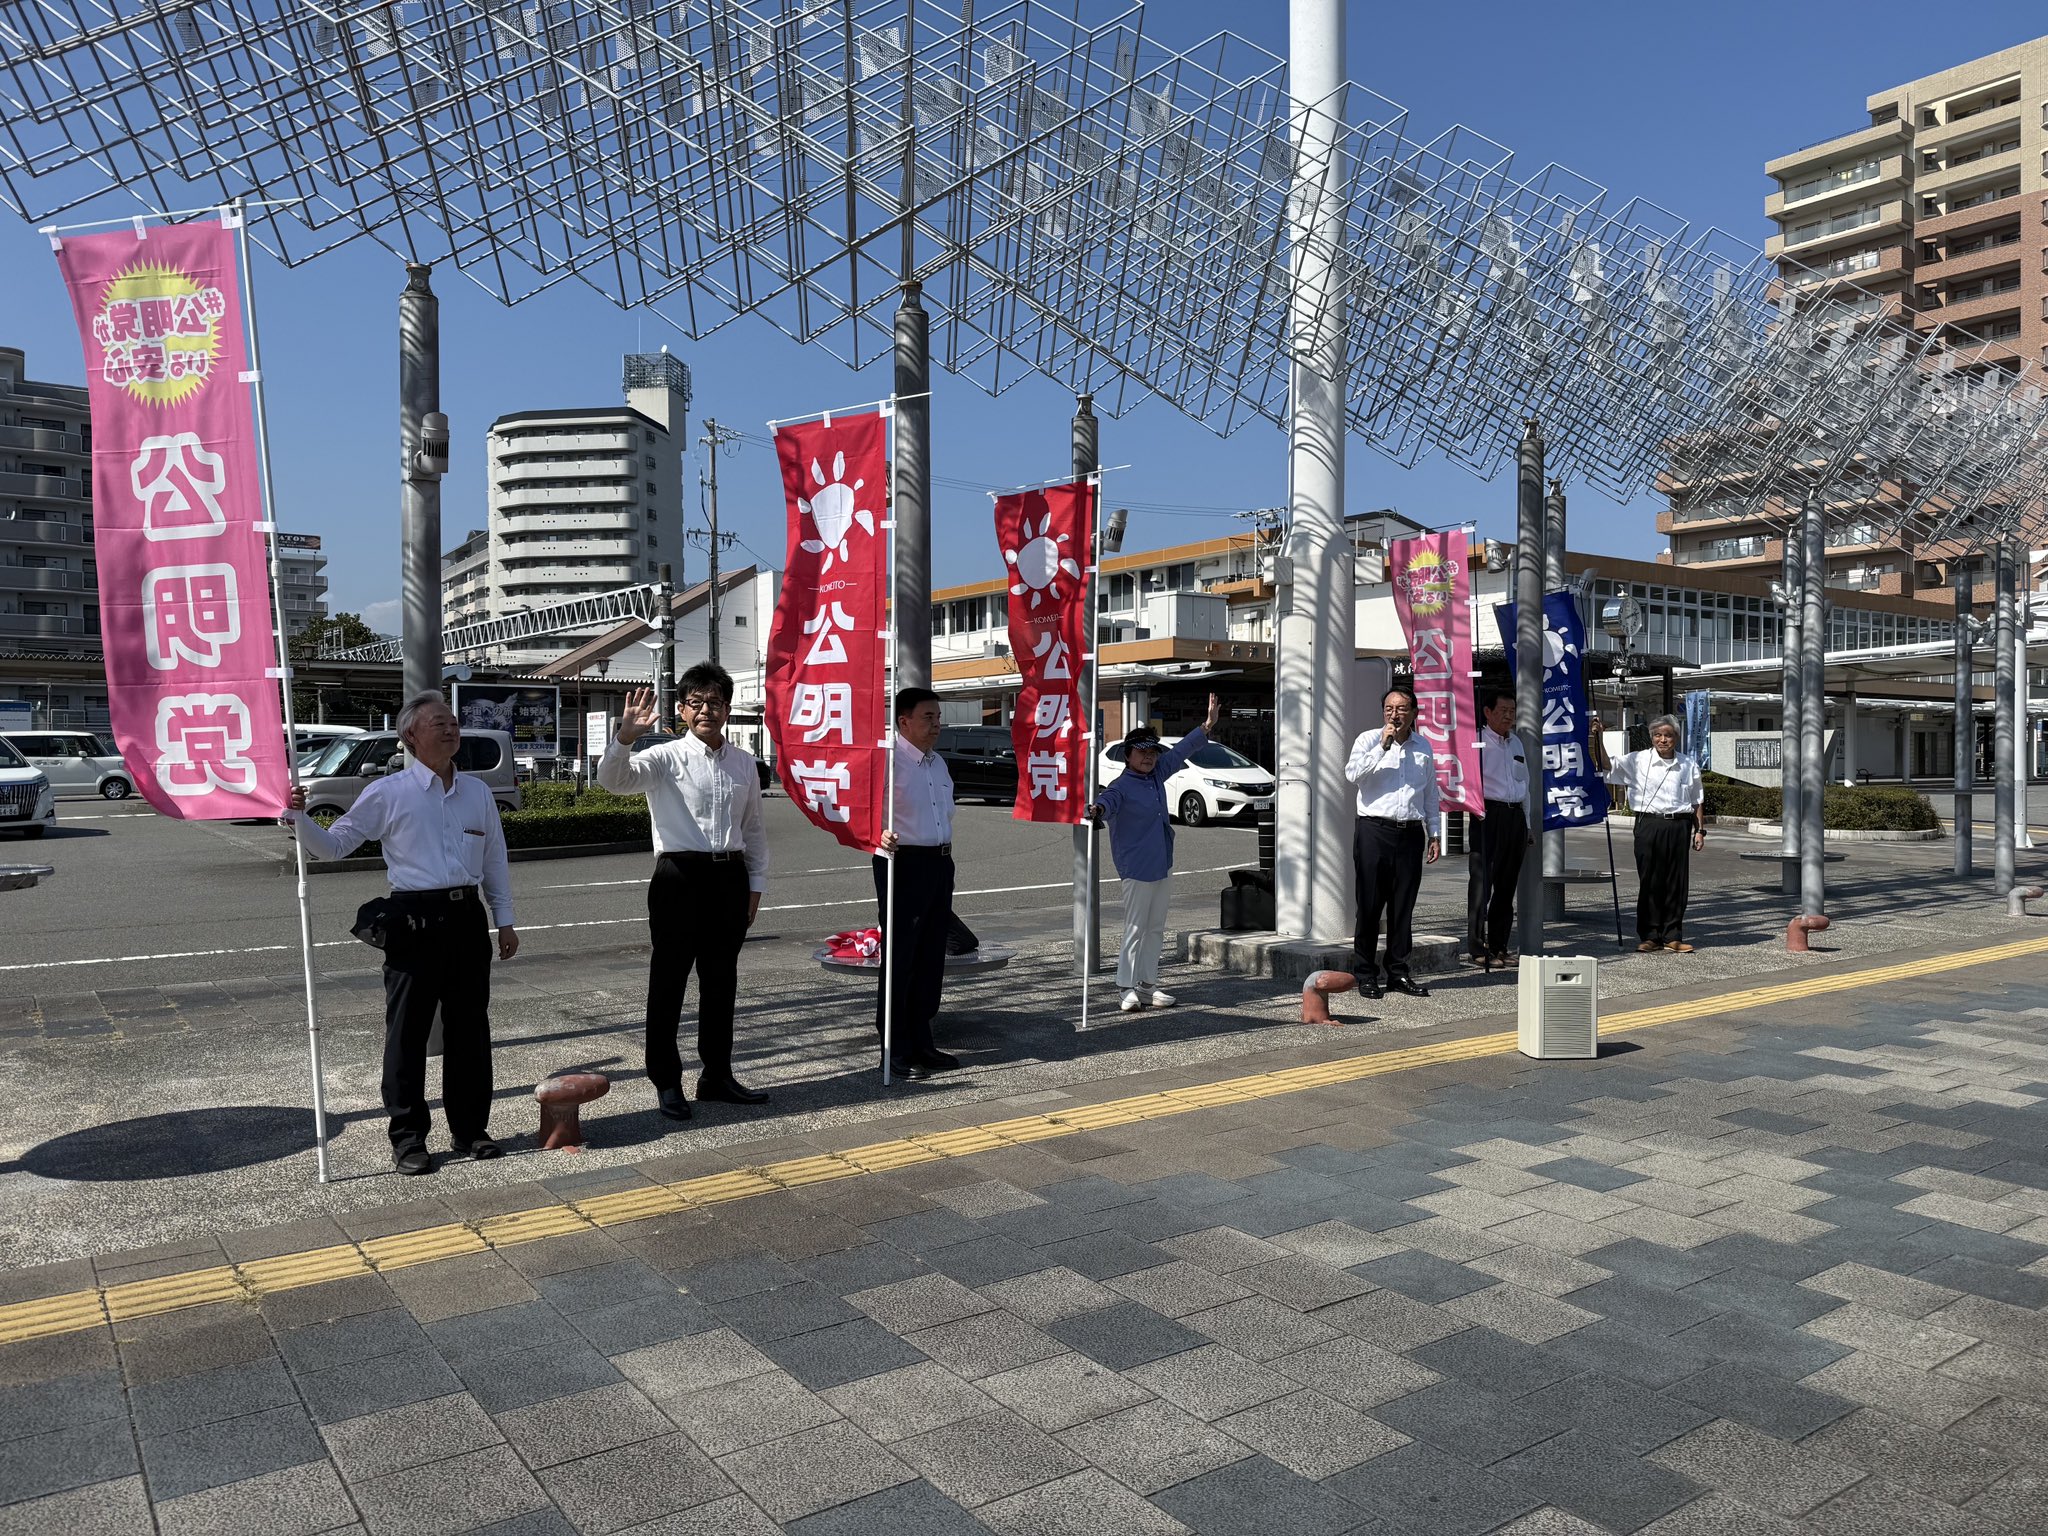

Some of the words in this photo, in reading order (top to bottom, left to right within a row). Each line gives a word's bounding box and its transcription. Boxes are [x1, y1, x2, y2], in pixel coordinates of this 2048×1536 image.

[788, 601, 855, 823] 公明党
[1027, 630, 1073, 801] 公明党
[1541, 696, 1593, 818] 公明党
